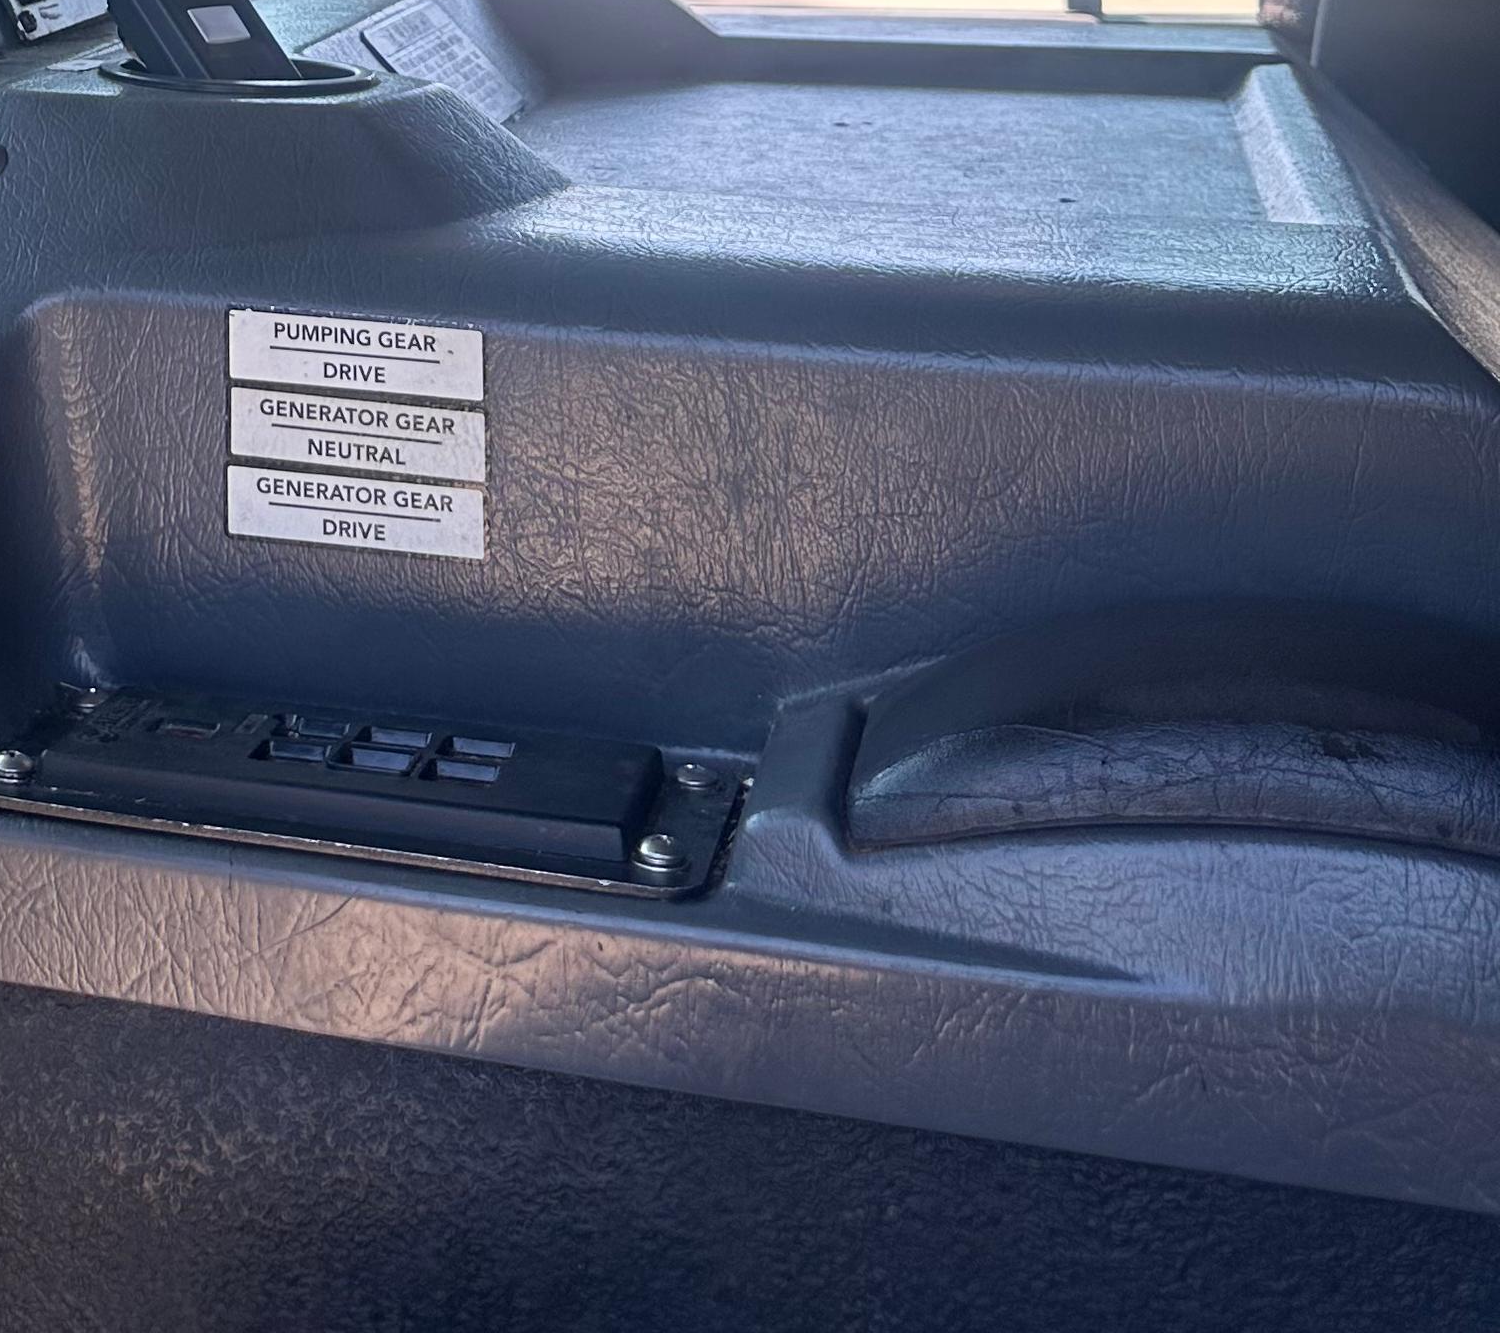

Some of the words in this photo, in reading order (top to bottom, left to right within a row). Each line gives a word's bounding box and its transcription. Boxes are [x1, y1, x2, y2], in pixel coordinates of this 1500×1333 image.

[273, 322, 371, 346] PUMPING
[378, 331, 436, 352] GEAR
[323, 362, 386, 383] DRIVE
[259, 399, 389, 428] GENERATOR
[395, 413, 455, 434] GEAR
[308, 438, 406, 465] NEUTRAL
[256, 477, 386, 506] GENERATOR
[393, 490, 453, 512] GEAR
[323, 519, 386, 540] DRIVE
